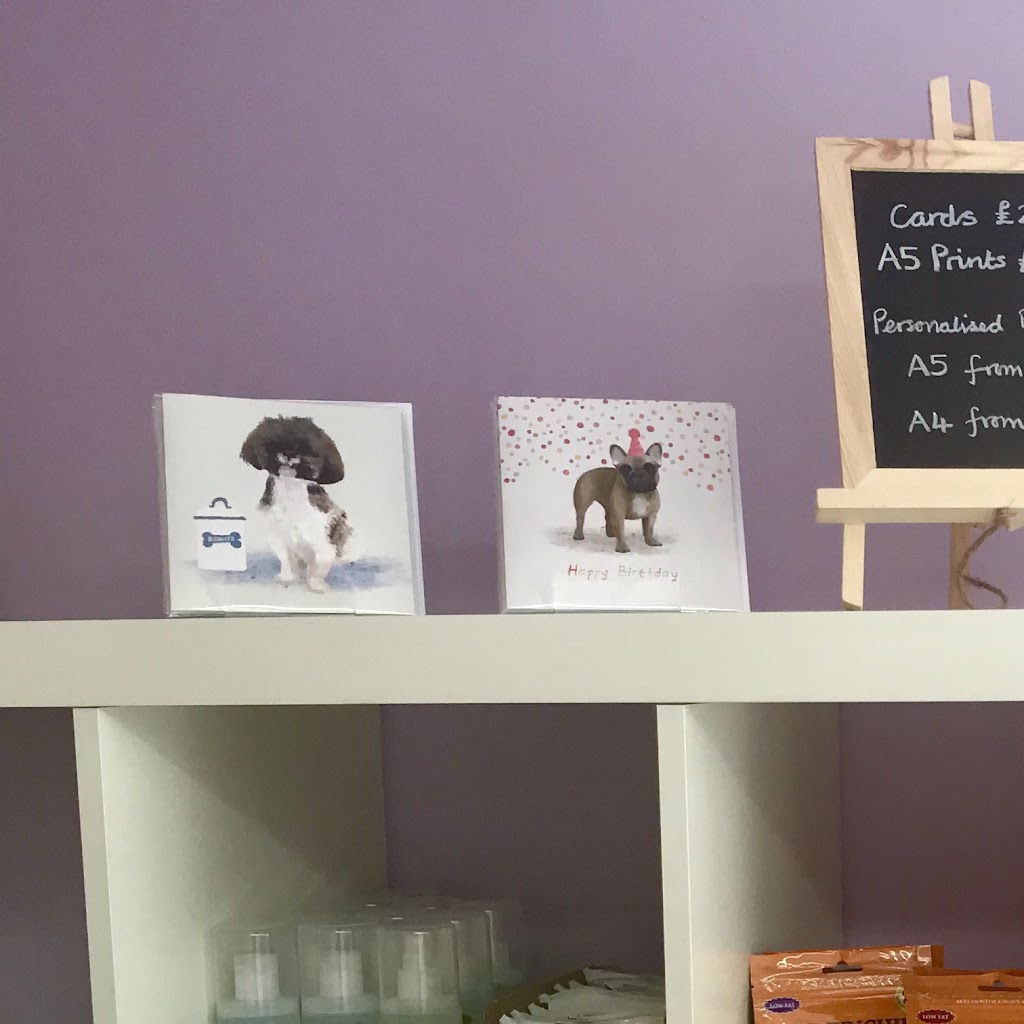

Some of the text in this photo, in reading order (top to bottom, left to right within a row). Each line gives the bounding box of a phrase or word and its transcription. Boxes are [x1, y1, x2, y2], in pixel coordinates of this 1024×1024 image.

[890, 203, 979, 229] Cards
[878, 243, 920, 271] A5
[932, 243, 1007, 273] Prints
[873, 308, 1005, 334] Personalised
[907, 354, 949, 377] A5
[964, 354, 1024, 385] from
[908, 409, 953, 434] A4
[568, 564, 679, 582] Happy Birthday
